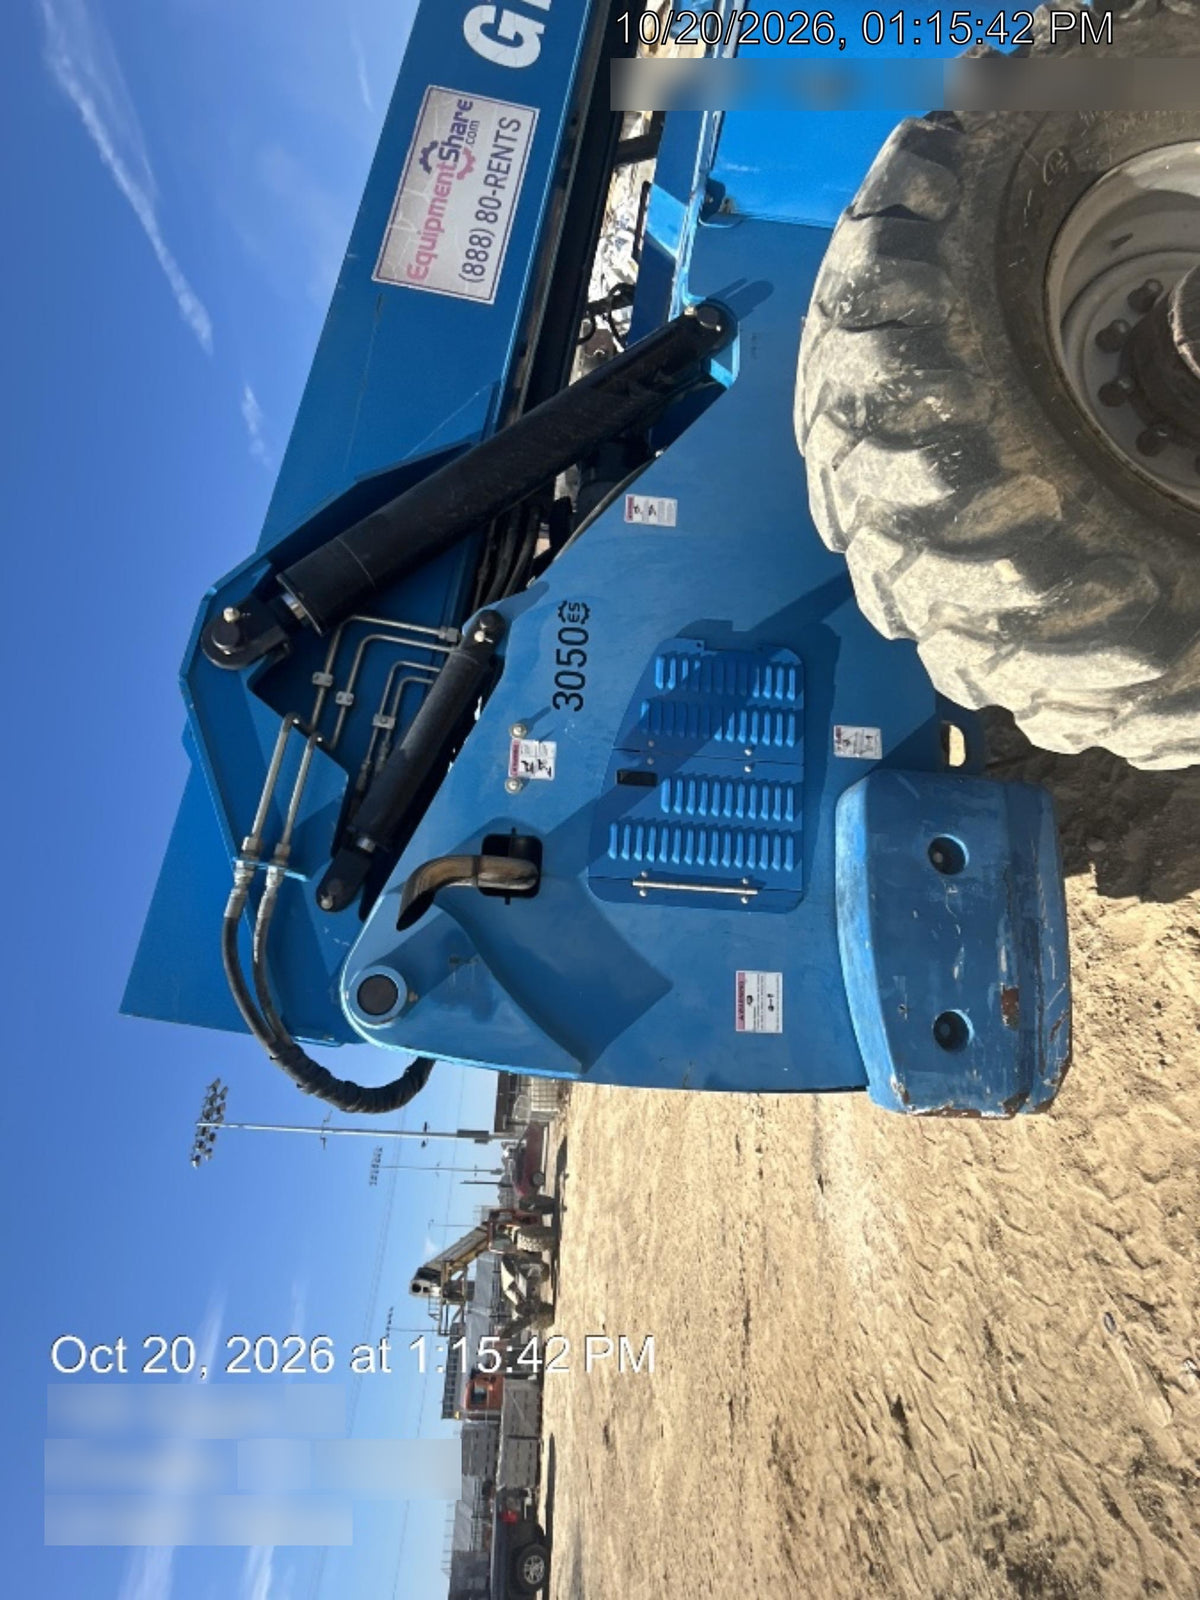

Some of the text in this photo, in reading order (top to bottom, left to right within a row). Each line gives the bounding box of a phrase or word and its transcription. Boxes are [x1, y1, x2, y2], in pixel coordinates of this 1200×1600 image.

[406, 98, 473, 281] EquipmentShare
[458, 116, 522, 283] (888) 80-RENTS
[552, 627, 589, 712] 3050
